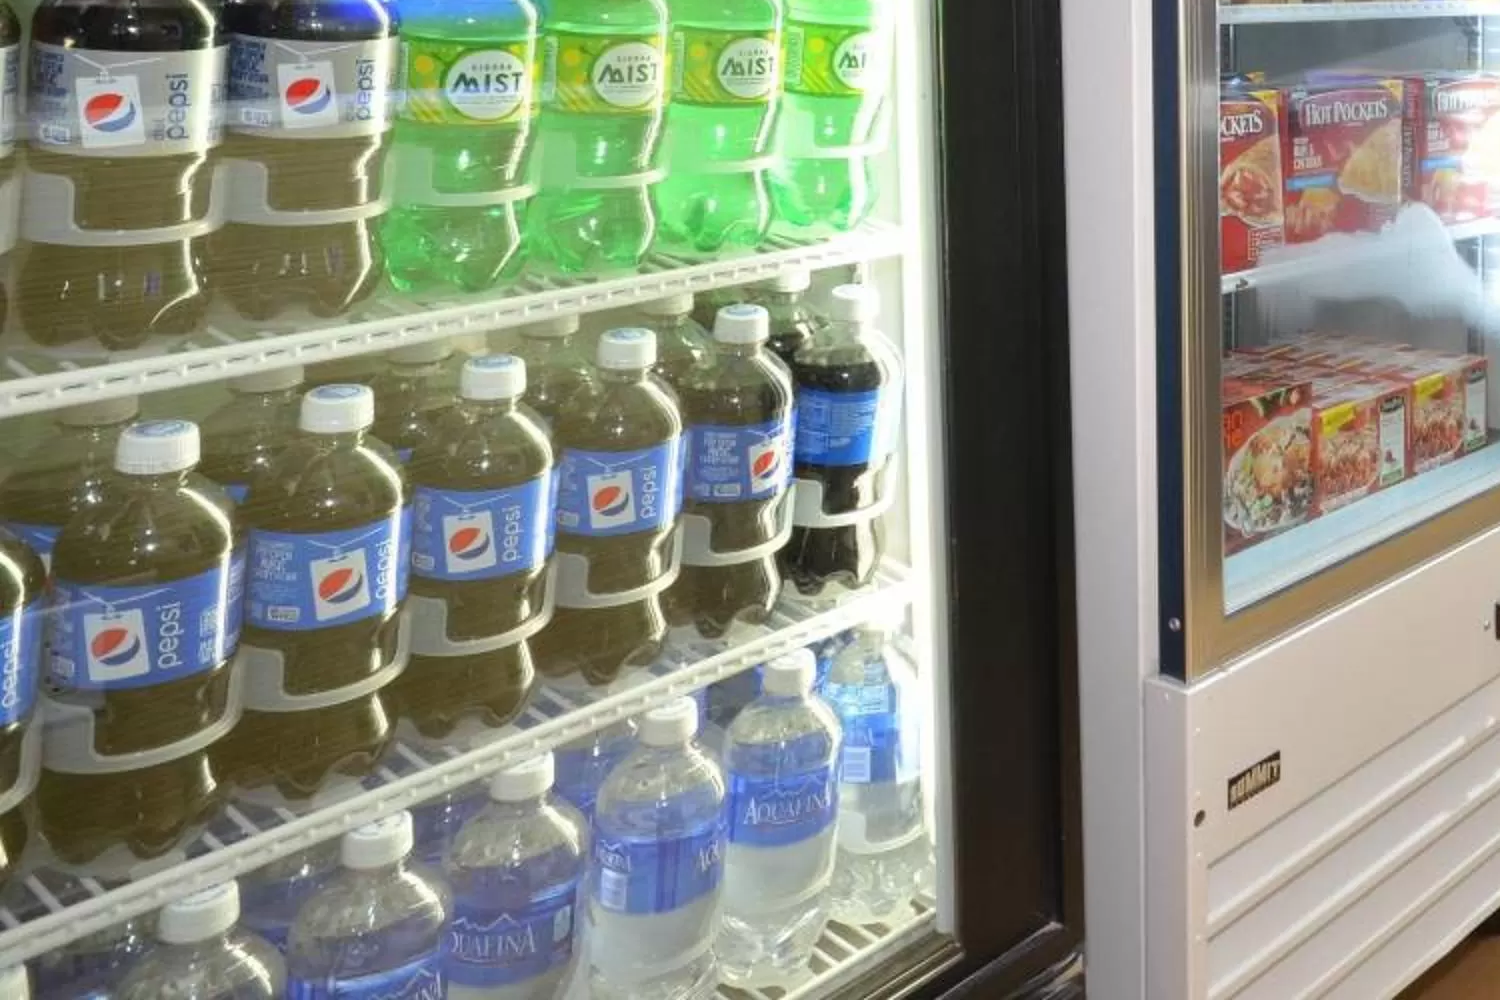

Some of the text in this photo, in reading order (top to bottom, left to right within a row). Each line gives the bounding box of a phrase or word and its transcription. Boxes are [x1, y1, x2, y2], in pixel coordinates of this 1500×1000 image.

[721, 56, 774, 76] MIST
[838, 51, 867, 70] MI
[451, 71, 522, 94] MIST
[597, 64, 658, 84] MIST
[165, 72, 192, 141] pepsi
[1333, 97, 1388, 123] POCKETS
[640, 464, 659, 519] pepsi
[502, 504, 525, 563] pepsi
[158, 600, 185, 669] pepsi
